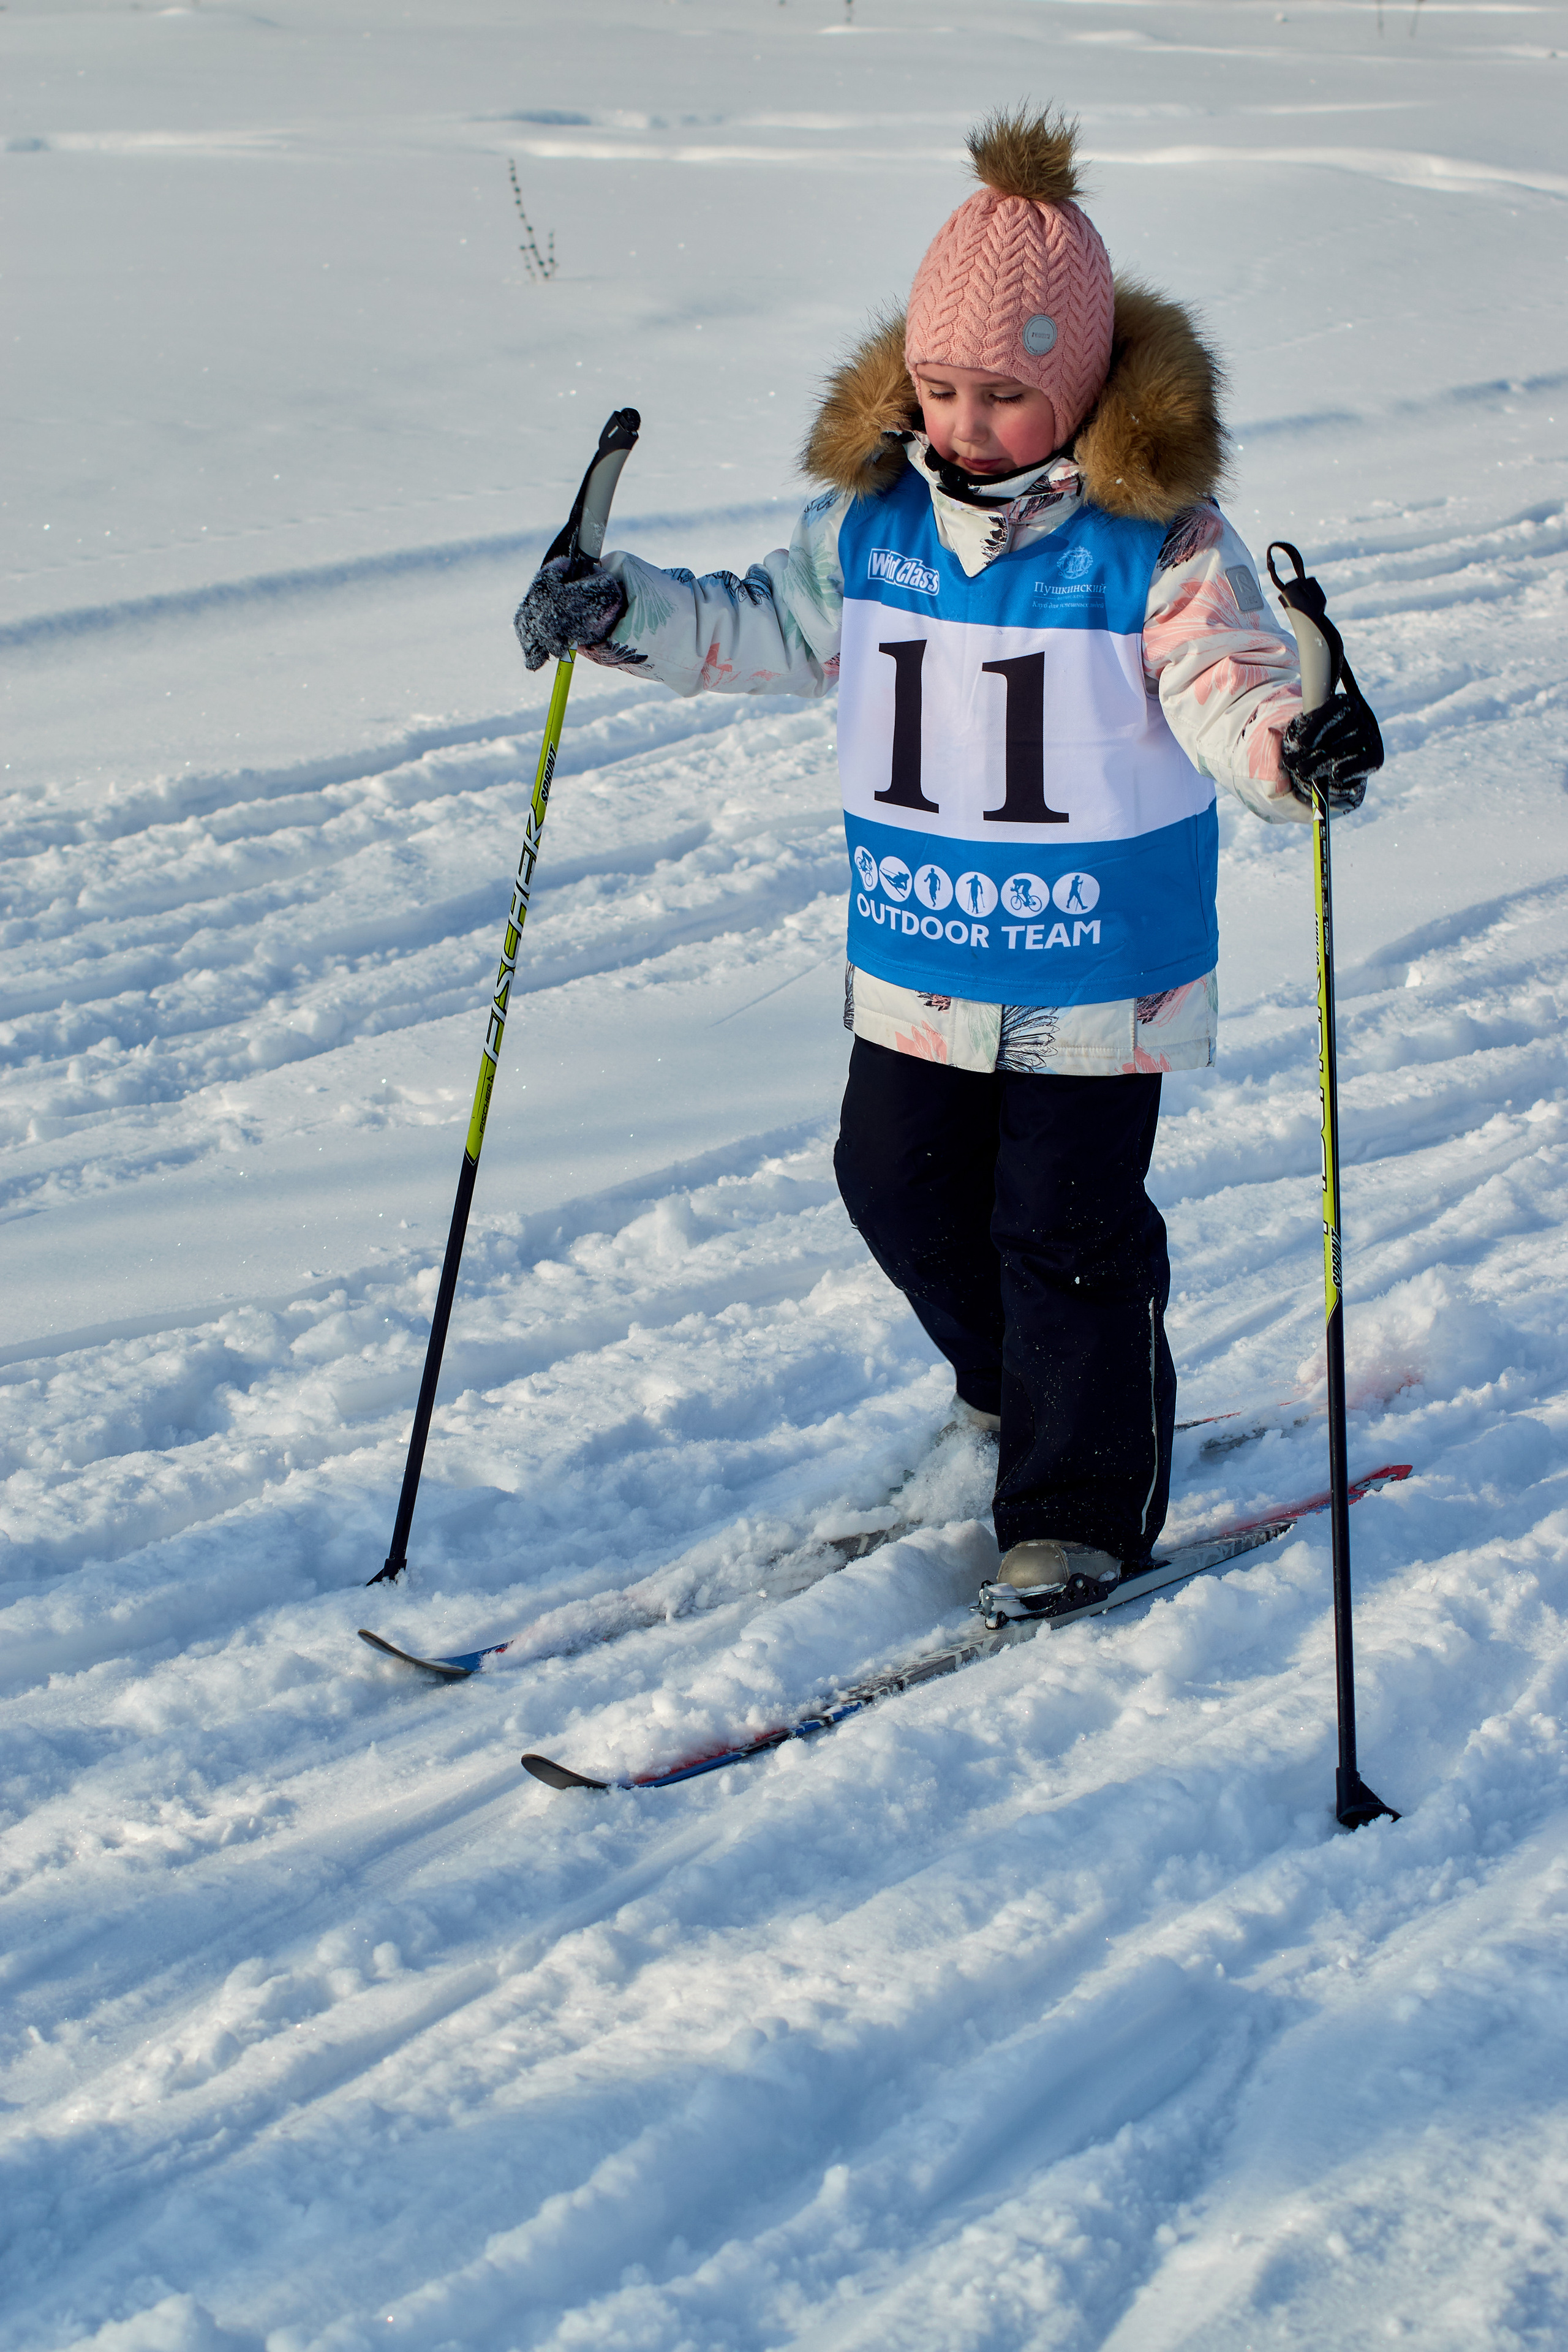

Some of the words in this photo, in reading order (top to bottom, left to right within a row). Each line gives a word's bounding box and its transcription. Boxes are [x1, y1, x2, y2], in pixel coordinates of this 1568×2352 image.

[1033, 581, 1106, 596] Пушкинский
[874, 639, 1069, 823] 11
[540, 742, 557, 807] SPRINT
[857, 892, 990, 949] OUTDOOR
[1001, 919, 1101, 950] TEAM
[479, 1083, 493, 1134] FISCHER
[1331, 1225, 1343, 1296] SPRINT
